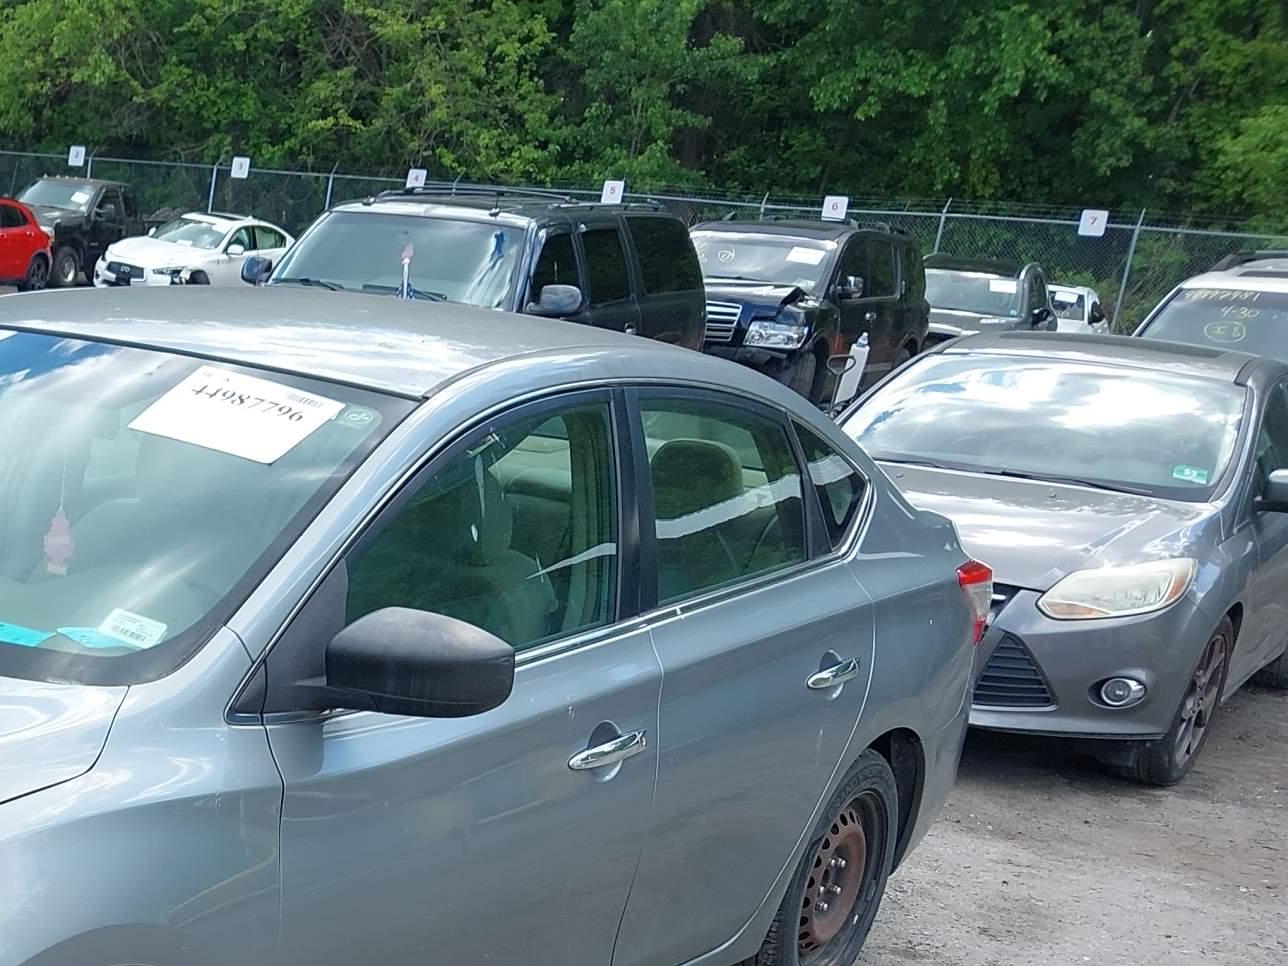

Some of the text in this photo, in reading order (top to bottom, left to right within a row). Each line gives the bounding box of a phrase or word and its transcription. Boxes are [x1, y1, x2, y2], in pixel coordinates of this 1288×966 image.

[609, 187, 617, 195] 5
[831, 202, 839, 211] 6
[1089, 216, 1099, 226] 7
[1220, 304, 1260, 319] 4-30
[192, 384, 304, 423] 44987796
